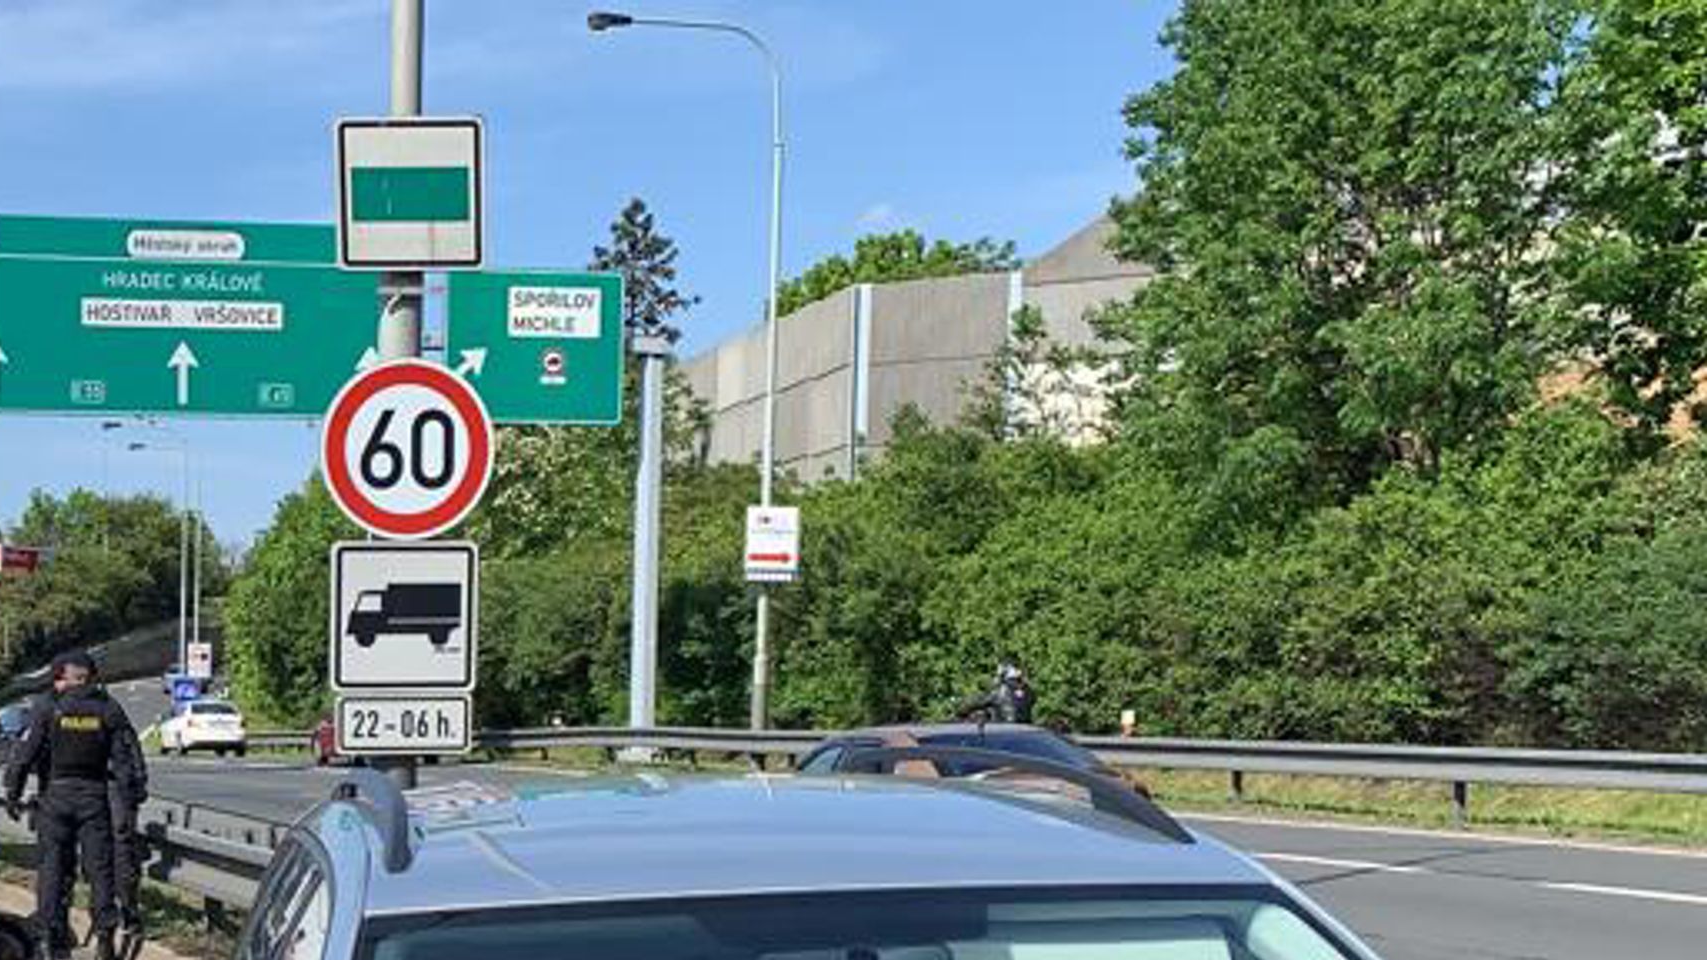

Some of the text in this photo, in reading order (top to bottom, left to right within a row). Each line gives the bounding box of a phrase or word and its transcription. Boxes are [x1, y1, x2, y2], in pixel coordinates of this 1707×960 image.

[102, 267, 263, 291] HRADEC KRÁLOVÉ
[194, 303, 278, 325] VRŠOVICE
[513, 316, 576, 332] MICHLE
[360, 409, 454, 489] 60
